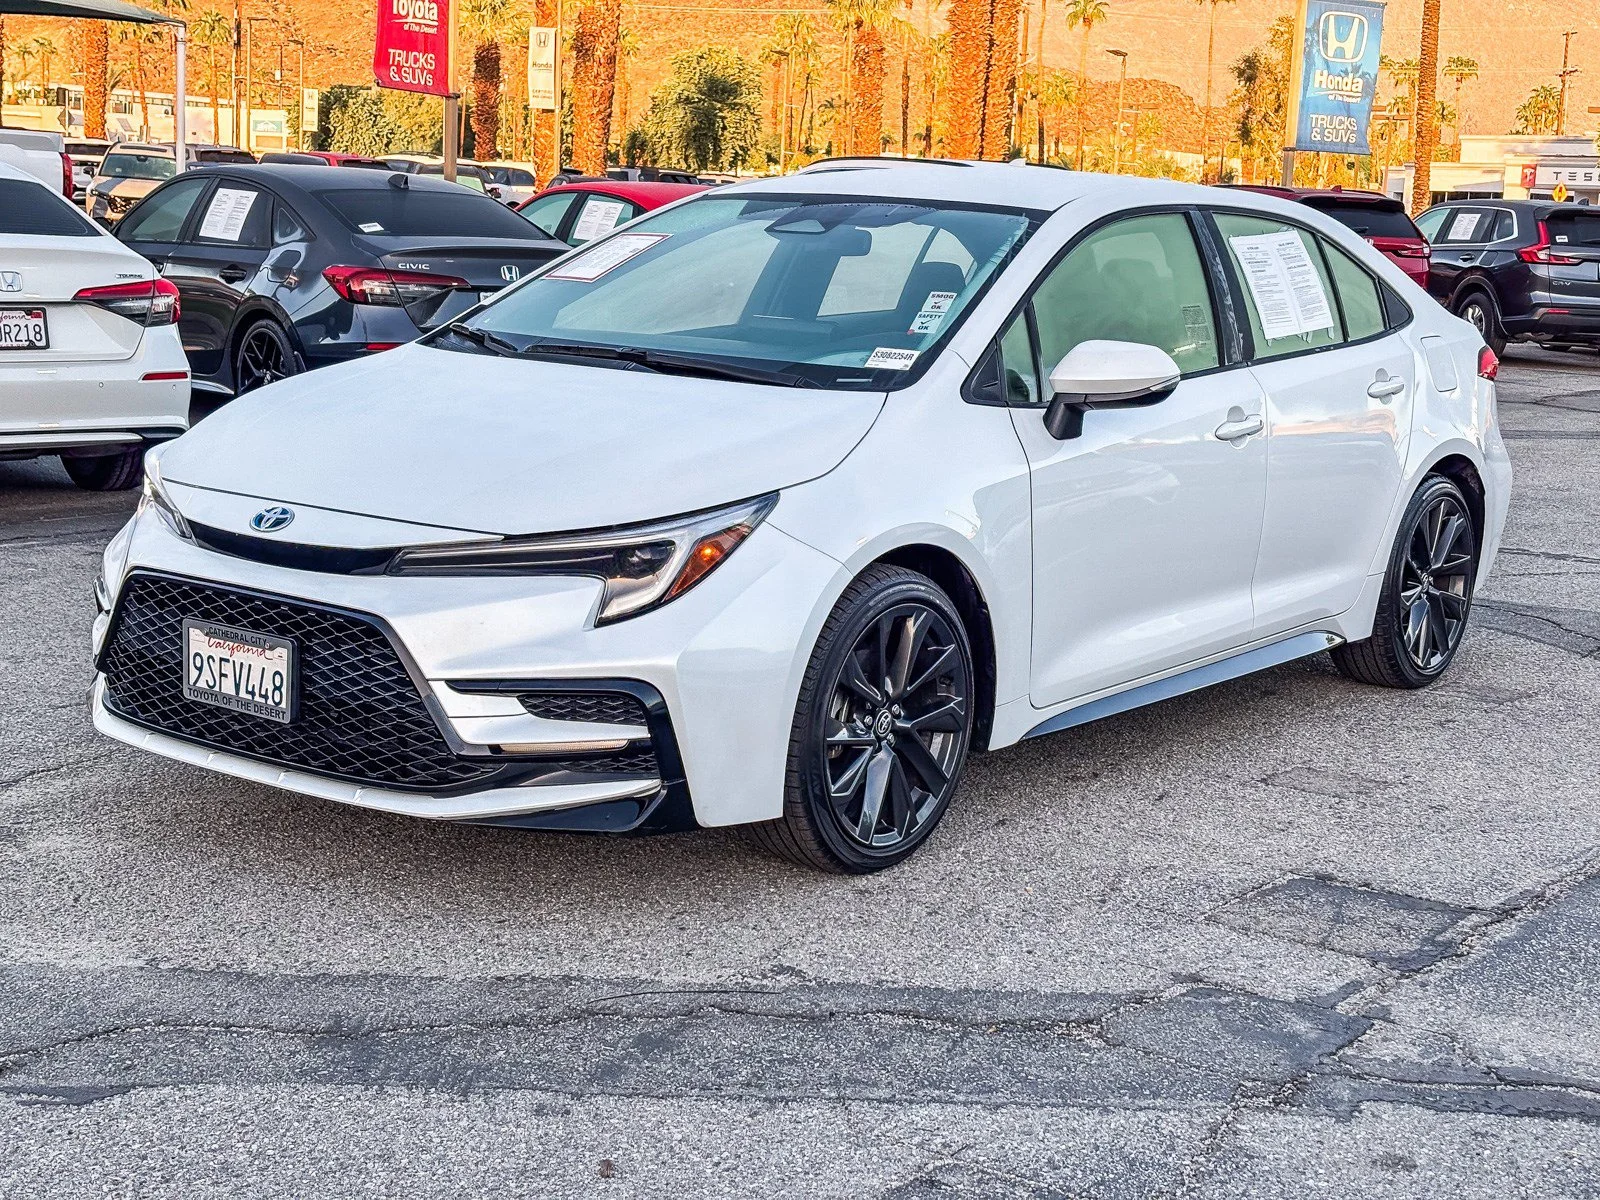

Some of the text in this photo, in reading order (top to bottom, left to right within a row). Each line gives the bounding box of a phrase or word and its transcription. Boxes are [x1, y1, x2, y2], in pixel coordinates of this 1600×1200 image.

[410, 23, 419, 32] The
[420, 25, 437, 34] Desert
[388, 48, 435, 70] TRUCKS
[389, 65, 433, 86] & SUVs
[1314, 70, 1363, 92] Honda
[1310, 114, 1357, 130] TRUCKS
[1311, 128, 1356, 143] & SUVs
[1553, 171, 1600, 181] TES
[208, 626, 267, 646] CATHEDRAL CITY
[207, 637, 273, 661] California
[192, 651, 284, 707] 9SFV448
[188, 688, 287, 721] TOYOTA OF THE DESERT
